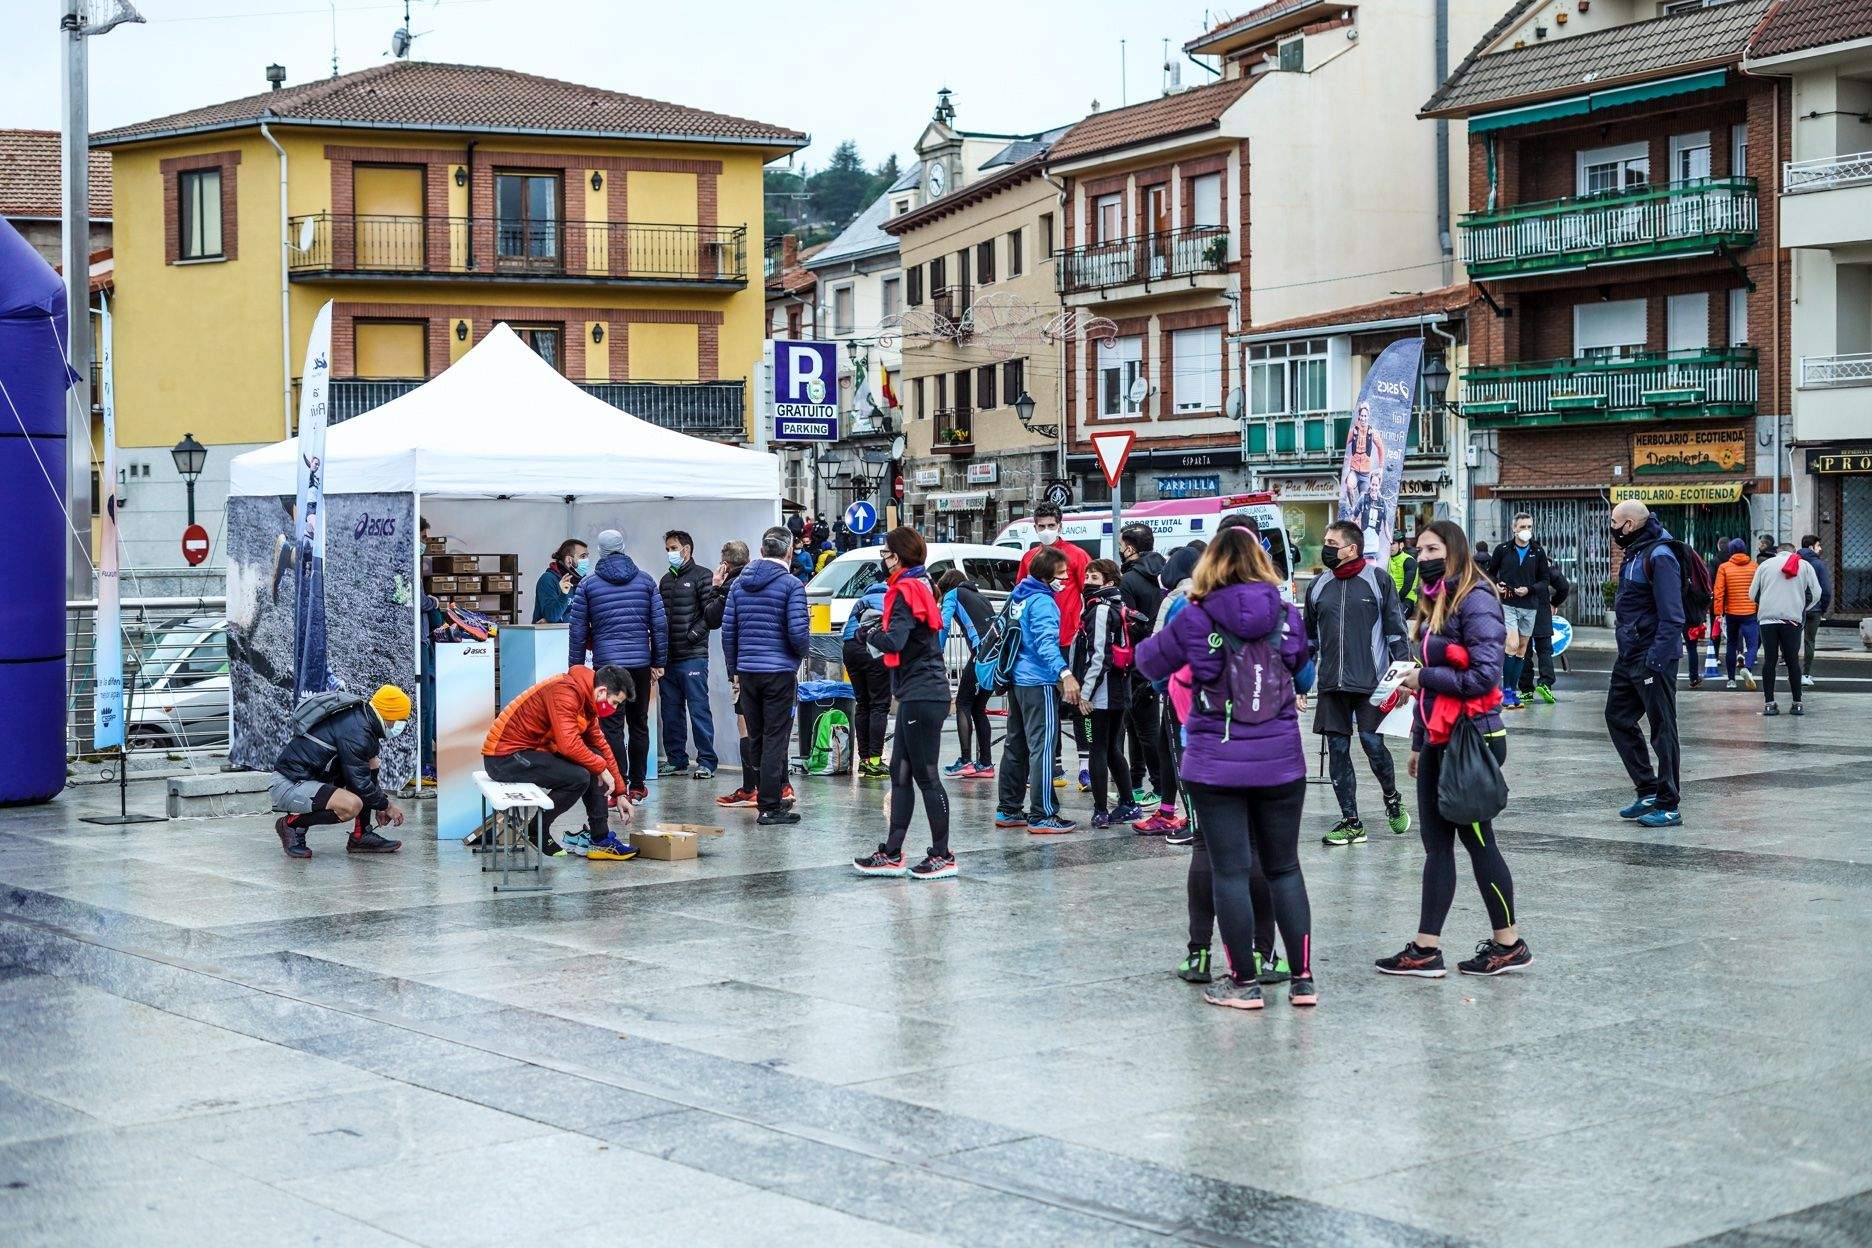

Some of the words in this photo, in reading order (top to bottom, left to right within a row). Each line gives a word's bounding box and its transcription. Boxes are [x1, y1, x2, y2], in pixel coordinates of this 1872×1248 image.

[789, 346, 823, 399] P
[777, 404, 834, 418] GRATUITO
[784, 424, 828, 434] PARKING
[1636, 432, 1689, 446] HERBOLARIO
[1696, 430, 1744, 444] ECOTIENDA
[1182, 455, 1211, 466] ESPARTA
[1158, 479, 1215, 491] PARRILLA
[1616, 490, 1674, 500] HERBOLARIO
[1680, 488, 1735, 500] ECOTIENDA
[368, 518, 395, 536] asics
[1161, 518, 1182, 526] VITAL
